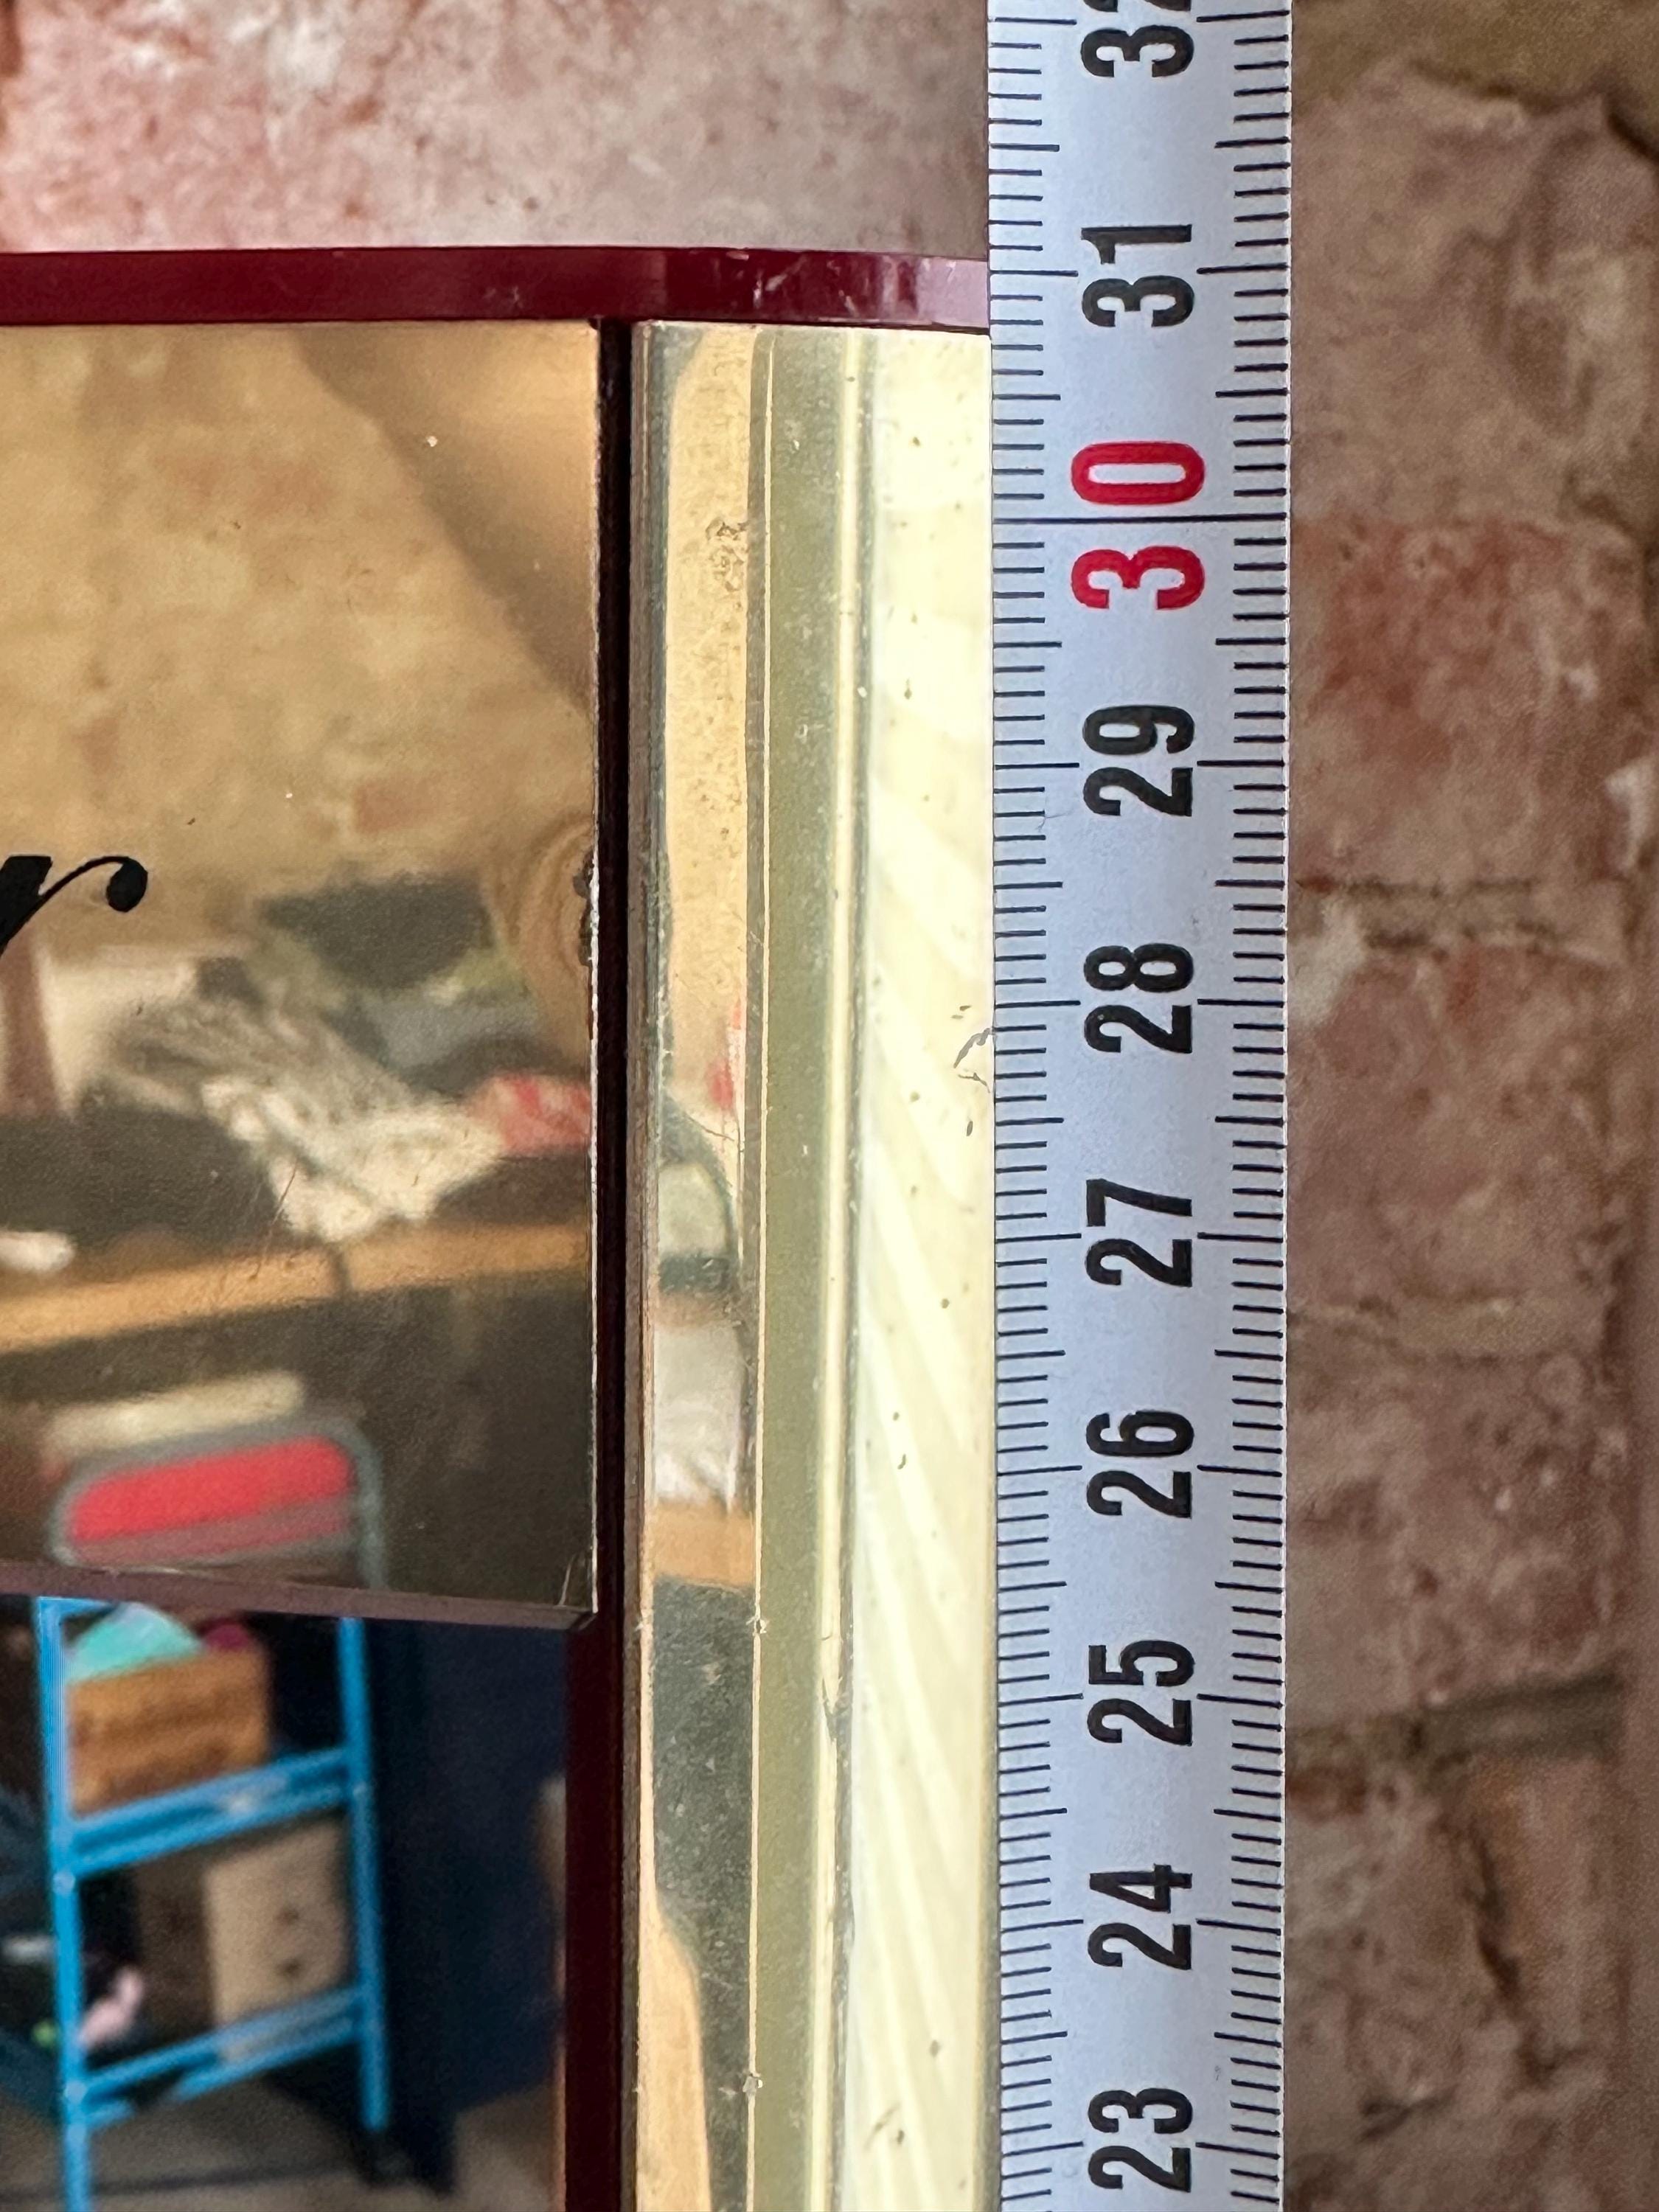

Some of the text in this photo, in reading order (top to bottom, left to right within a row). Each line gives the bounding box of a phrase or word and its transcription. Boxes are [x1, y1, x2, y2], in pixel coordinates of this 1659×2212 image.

[1081, 0, 1194, 77] 3
[1081, 224, 1194, 327] 31
[1071, 442, 1205, 609] 30
[1082, 706, 1194, 817] 29
[1084, 943, 1194, 1054] 28
[1086, 1179, 1192, 1287] 27
[1086, 1411, 1194, 1519] 26
[1087, 1641, 1195, 1747] 25
[1088, 1864, 1192, 1970] 24
[1088, 2088, 1193, 2193] 23
